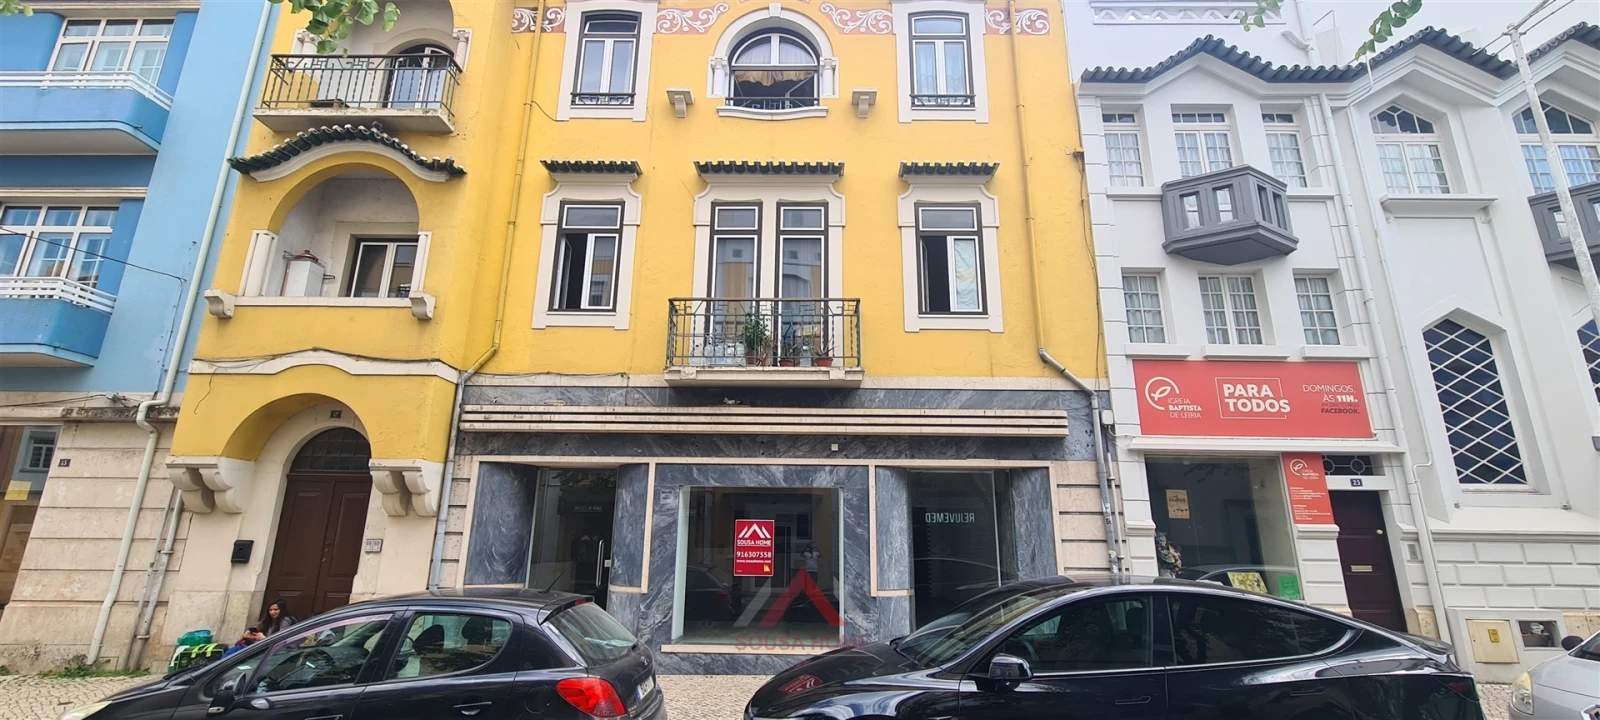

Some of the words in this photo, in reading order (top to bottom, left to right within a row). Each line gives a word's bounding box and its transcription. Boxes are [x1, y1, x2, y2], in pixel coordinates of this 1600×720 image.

[1222, 383, 1275, 397] PARA
[1302, 384, 1356, 394] DOMINGOS,
[1167, 397, 1191, 405] IGREJA
[1323, 392, 1336, 403] ÀS
[1336, 394, 1359, 403] 11H.
[1224, 398, 1291, 413] TODOS
[1169, 411, 1180, 419] DE
[1181, 411, 1202, 419] LEIRIA
